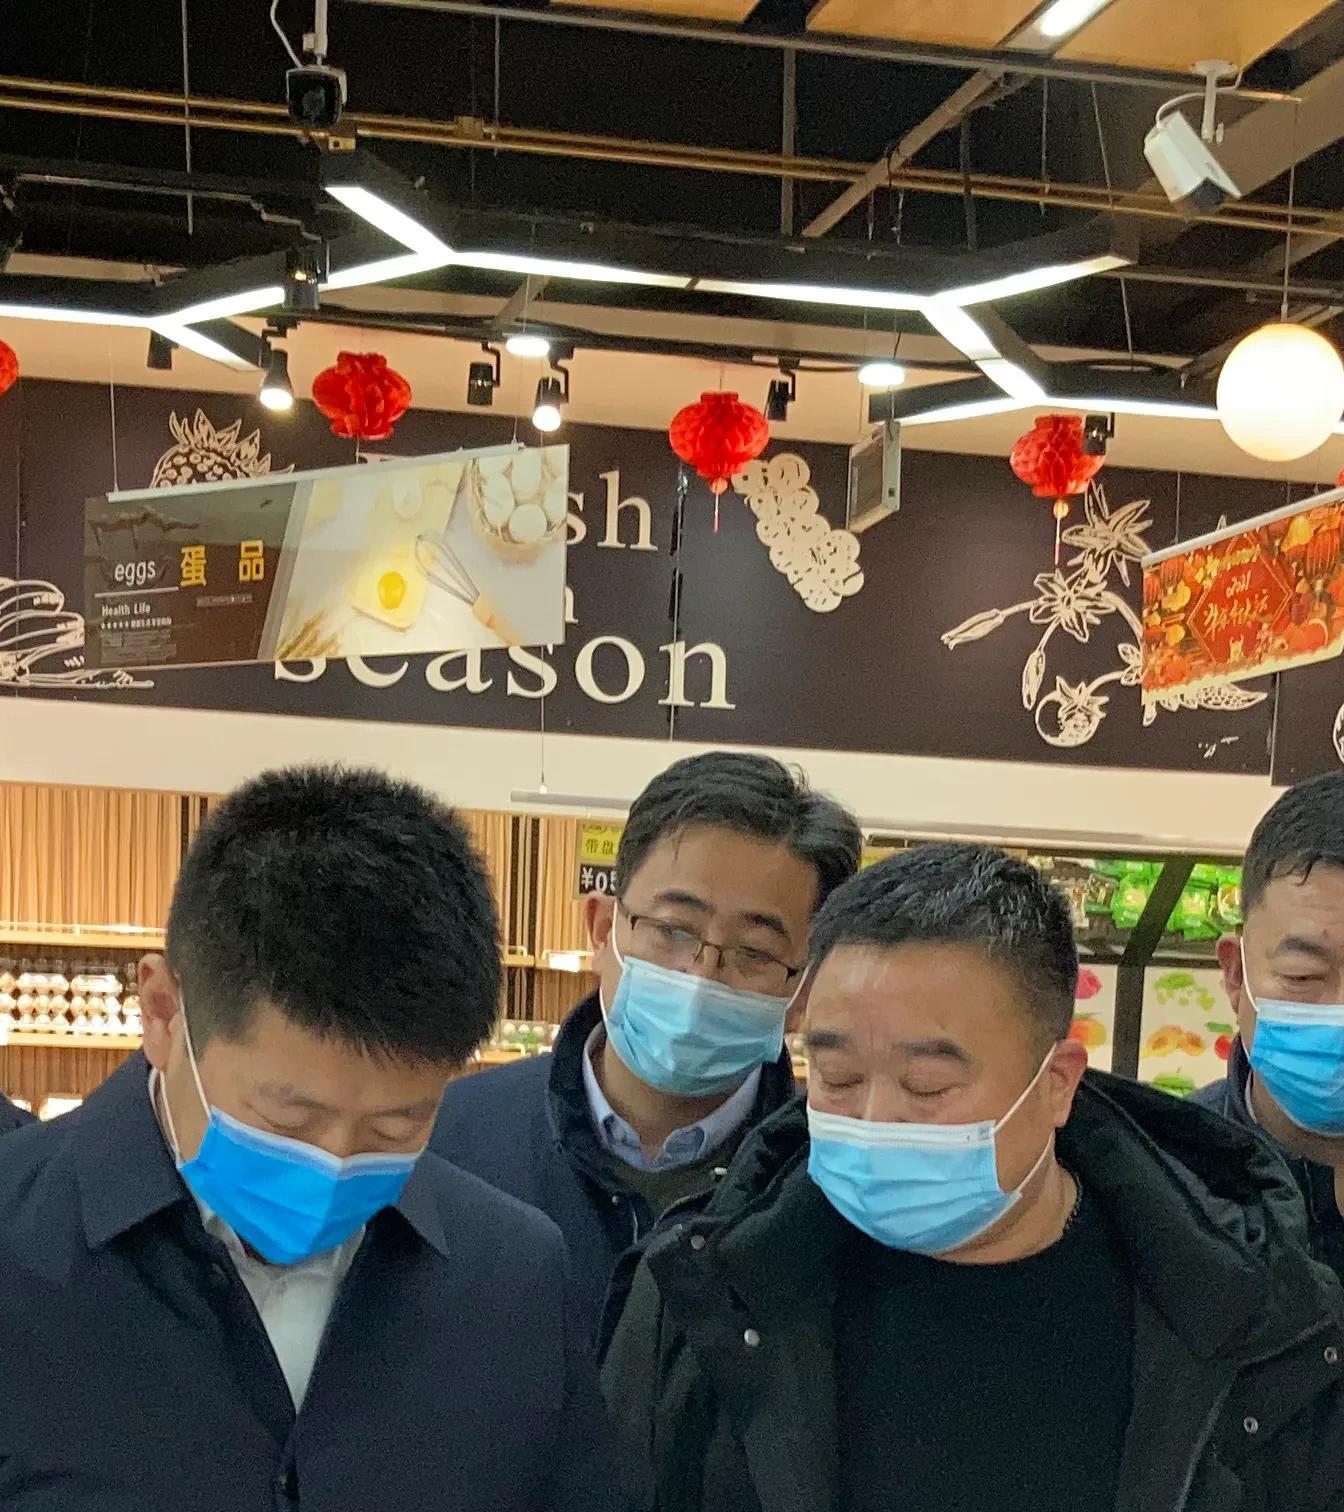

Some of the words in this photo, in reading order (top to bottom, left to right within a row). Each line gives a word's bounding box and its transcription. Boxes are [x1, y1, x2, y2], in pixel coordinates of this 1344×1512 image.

[114, 560, 156, 587] eggs
[101, 603, 130, 617] Health
[134, 601, 151, 615] Life
